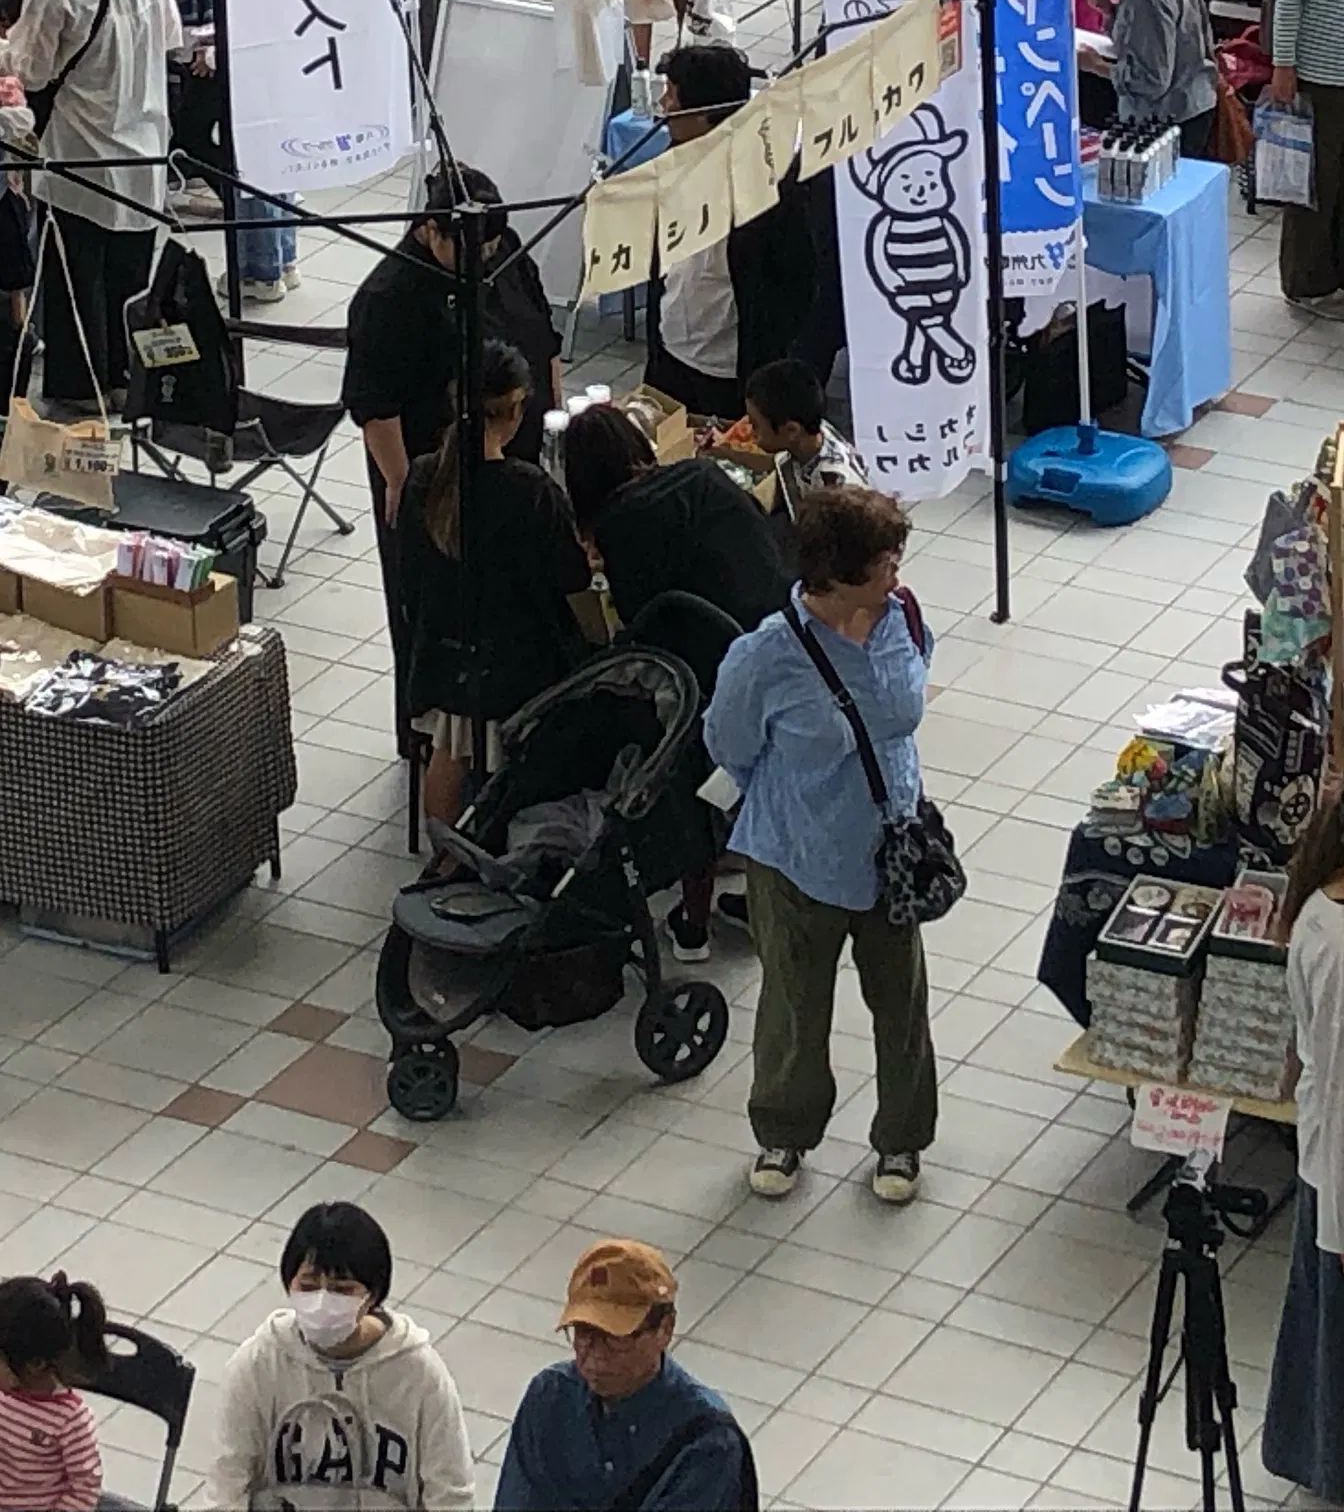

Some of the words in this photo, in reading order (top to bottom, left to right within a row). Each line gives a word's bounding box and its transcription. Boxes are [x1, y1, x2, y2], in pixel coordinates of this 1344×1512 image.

[813, 61, 925, 160] フルカワ
[276, 1416, 408, 1488] GAP
